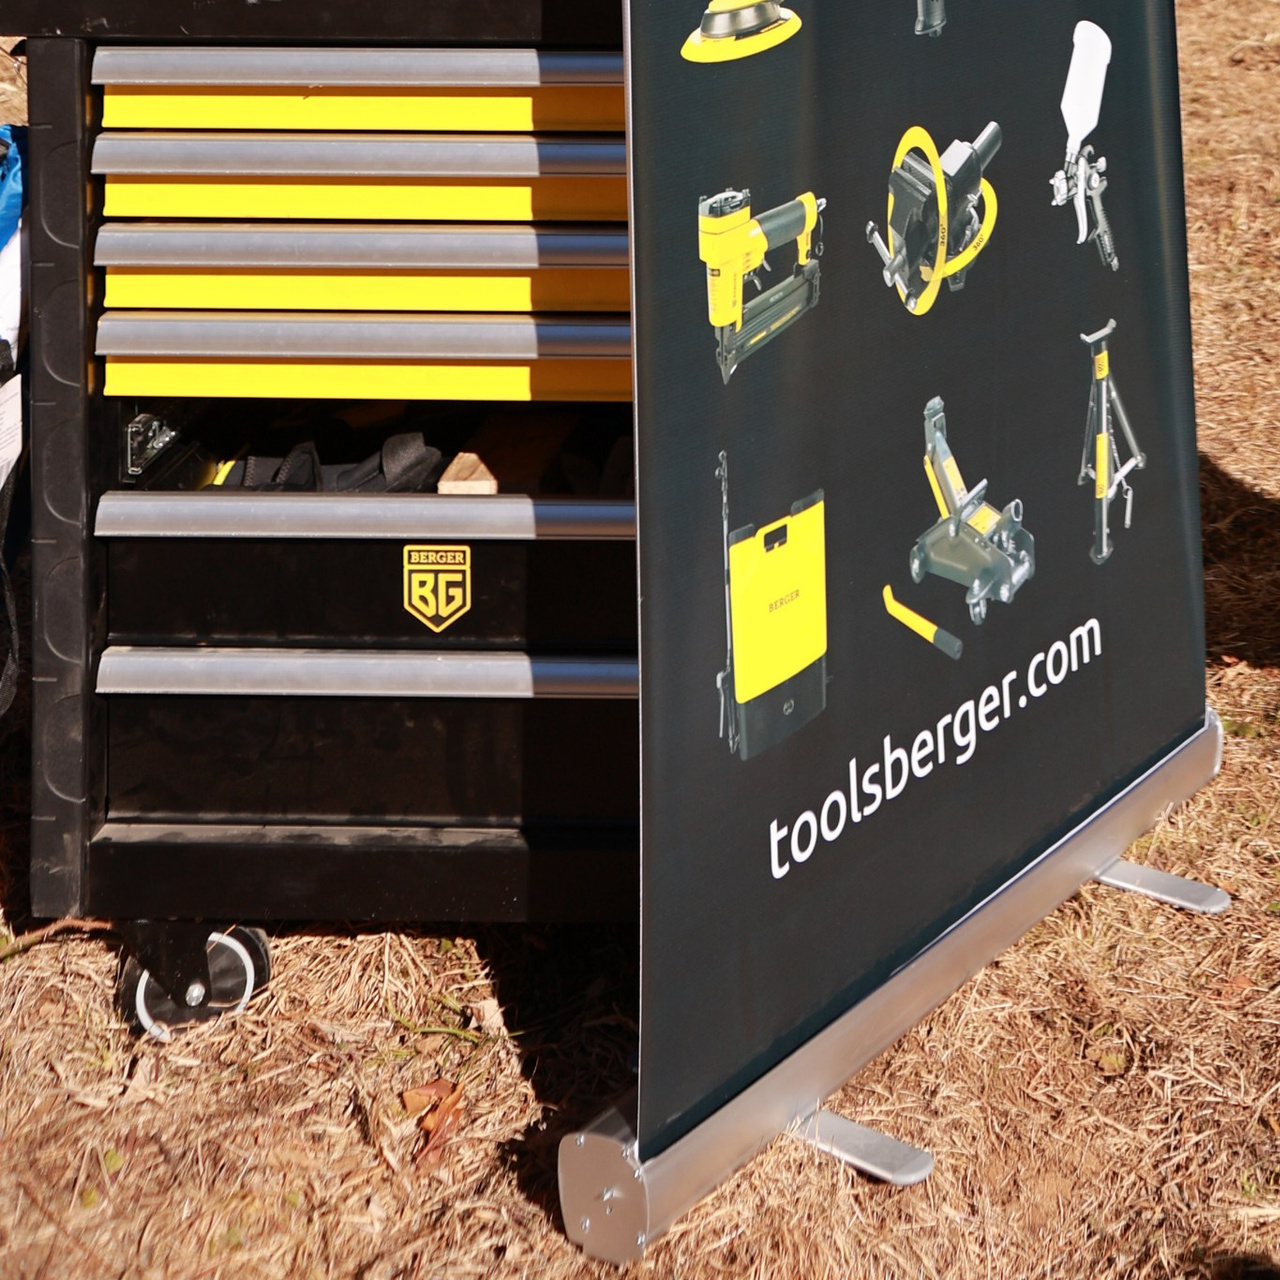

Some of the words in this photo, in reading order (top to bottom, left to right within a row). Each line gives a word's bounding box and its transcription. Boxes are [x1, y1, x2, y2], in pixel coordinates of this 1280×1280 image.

[410, 552, 464, 564] BERGER
[411, 573, 463, 618] BG
[768, 589, 801, 613] BERGER
[769, 617, 1102, 880] toolsberger.com
